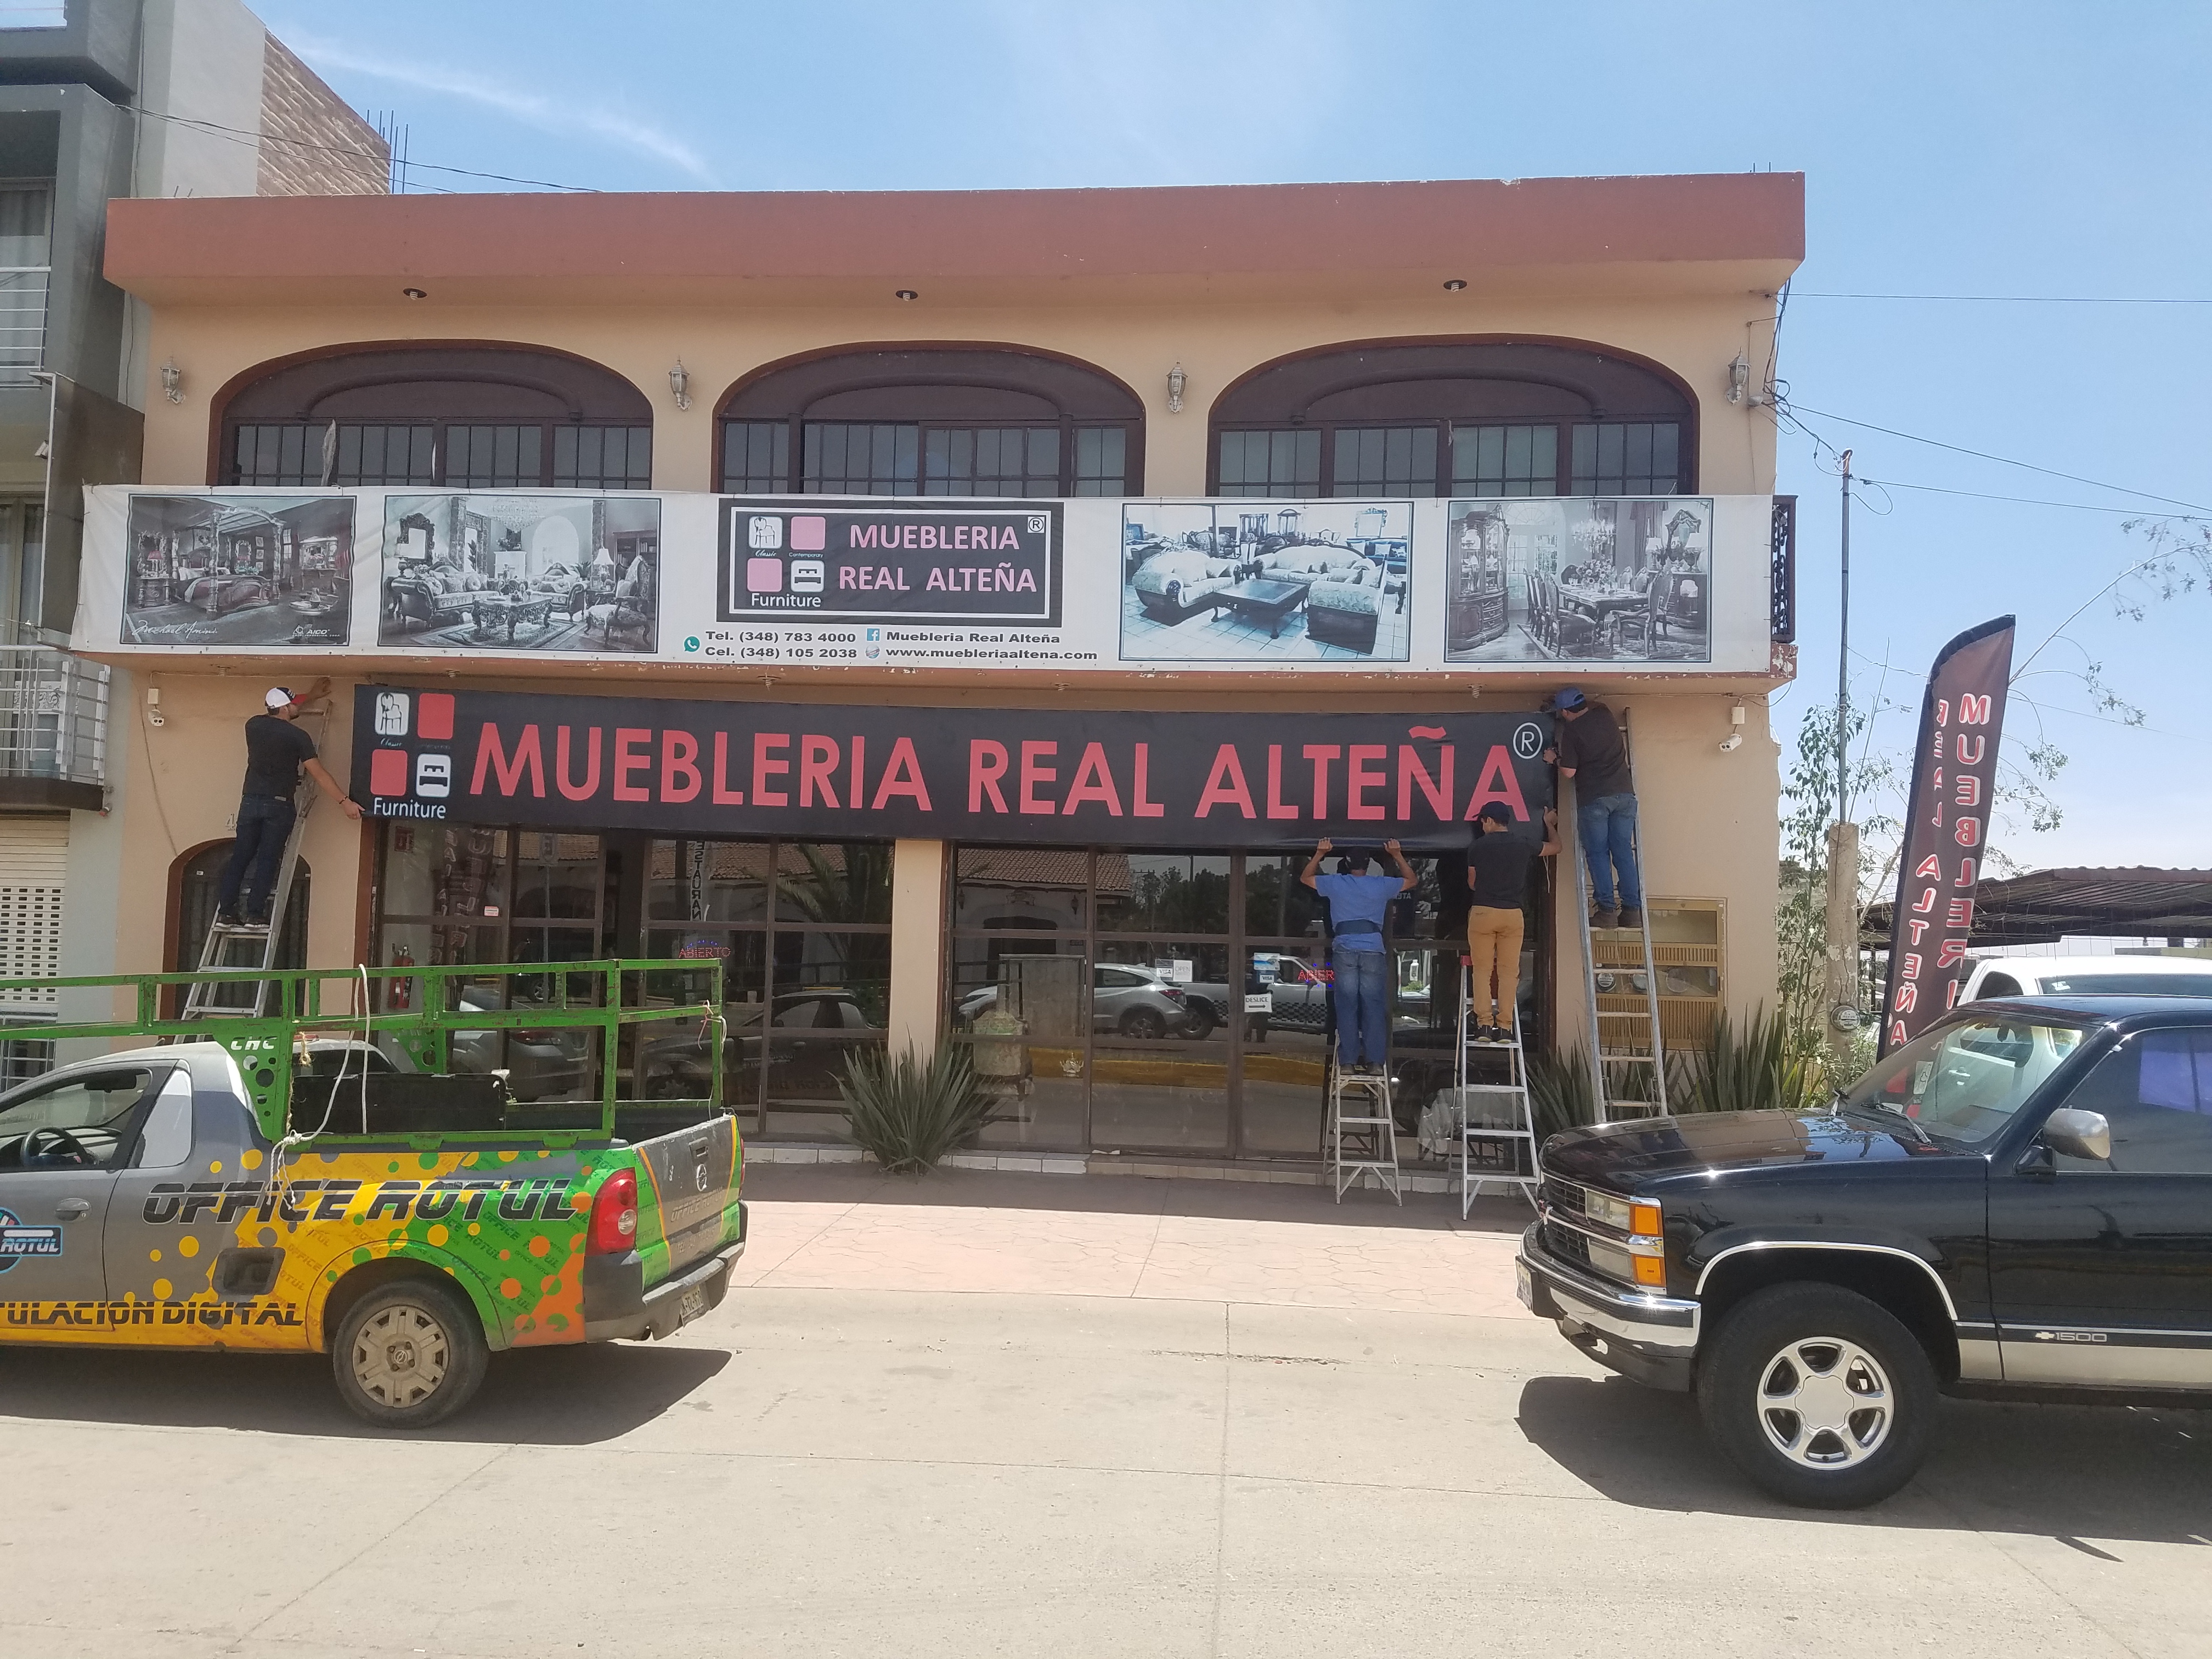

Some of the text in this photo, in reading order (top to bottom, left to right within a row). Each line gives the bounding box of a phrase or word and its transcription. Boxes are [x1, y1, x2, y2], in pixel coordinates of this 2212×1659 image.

[850, 524, 1020, 550] MUEBLERIA
[839, 562, 1037, 592] REAL ALTEÑA
[751, 592, 822, 607] Furniture
[705, 631, 856, 642] Tel. (348) 783 4000
[886, 631, 1060, 644] Muebleria Real Alteña
[705, 647, 857, 659] Cel. (348) 105 2038
[885, 648, 1098, 660] www.muebleriaaltena.com
[470, 722, 933, 811] MUEBLERIA
[968, 739, 1165, 817] REAL
[1194, 725, 1531, 822] ALTEÑA
[373, 797, 447, 819] Furniture
[678, 946, 732, 958] ABIERTO
[142, 1178, 579, 1225] OFFICE ROTUL
[1, 1238, 60, 1252] ROTUL
[0, 1301, 304, 1326] ULACION DIGITAL
[2055, 1331, 2107, 1342] 1500
